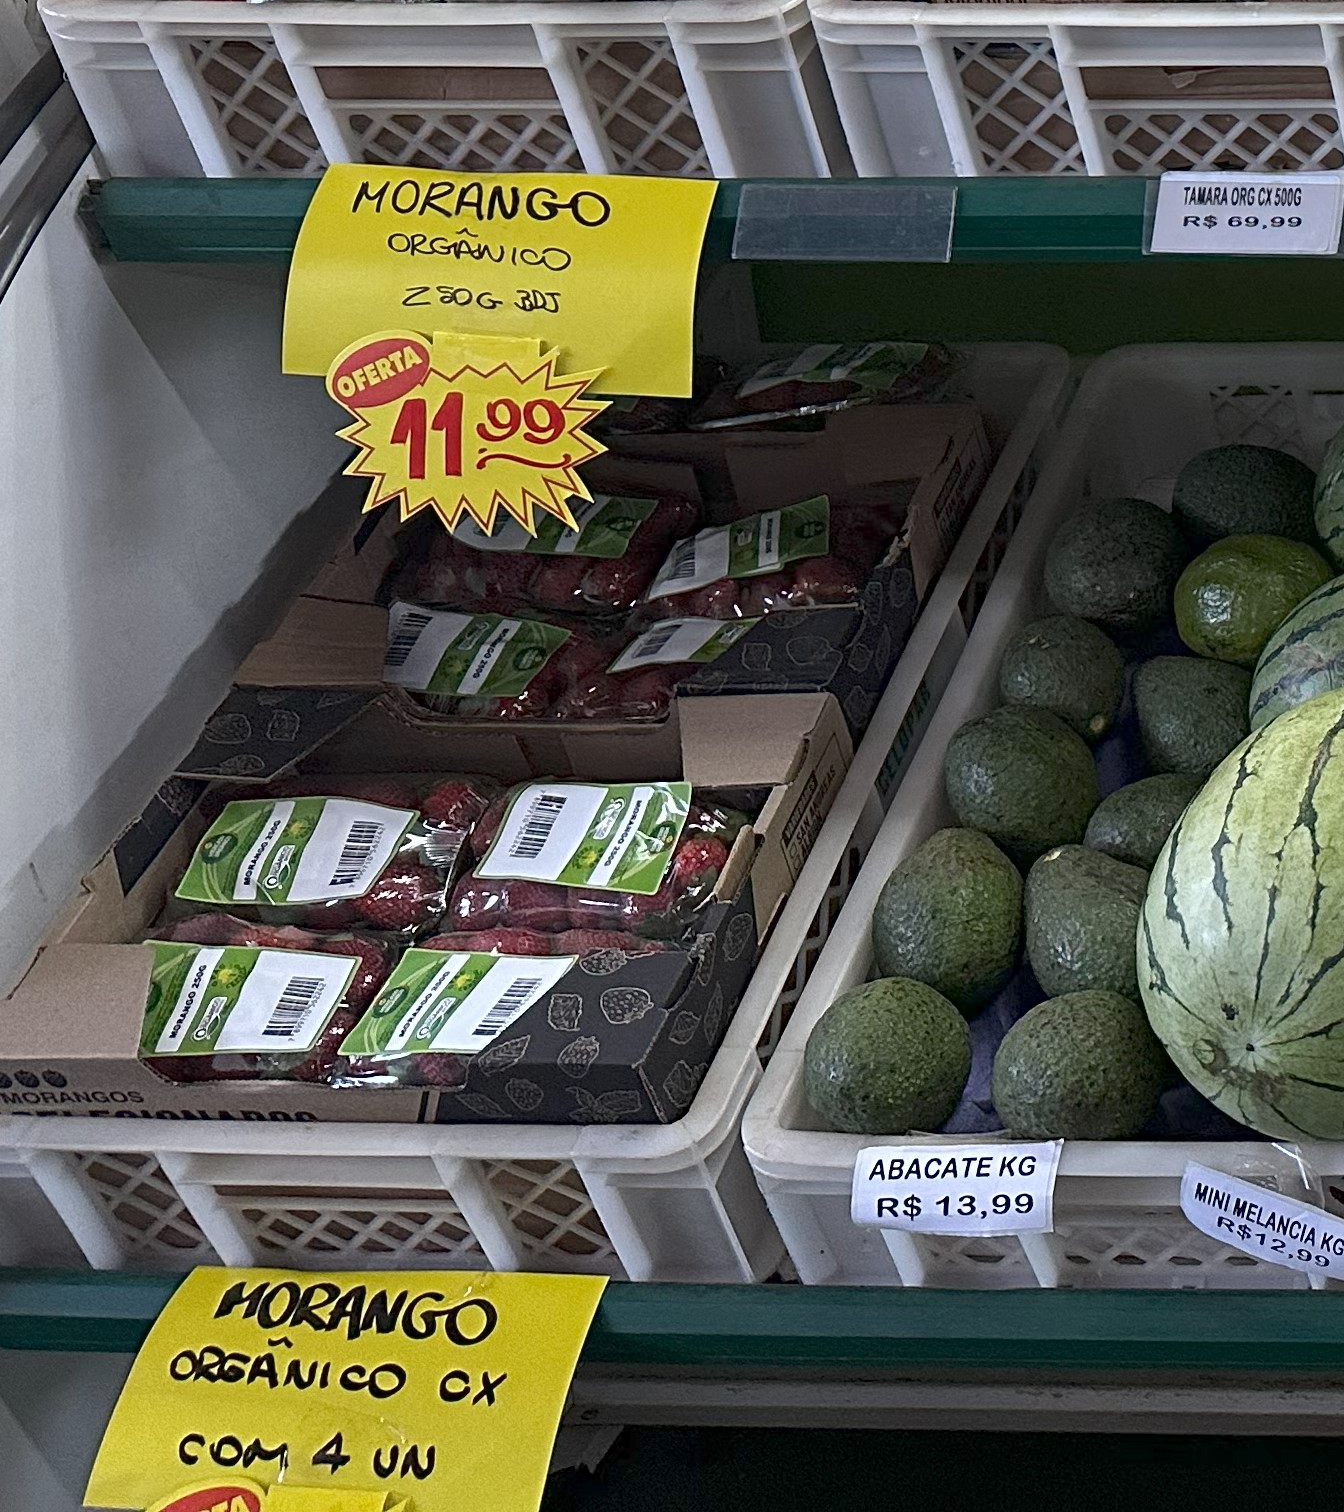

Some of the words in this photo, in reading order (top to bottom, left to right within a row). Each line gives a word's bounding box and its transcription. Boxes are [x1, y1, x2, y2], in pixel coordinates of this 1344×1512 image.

[352, 180, 610, 227] MORANGO
[1184, 187, 1228, 206] TAMARA
[1231, 187, 1255, 206] ORG
[1258, 187, 1272, 206] CX
[1274, 188, 1302, 206] 500G
[1183, 215, 1217, 229] R$
[1227, 216, 1302, 230] 69,99
[387, 228, 572, 271] ORGÂNICO
[402, 286, 503, 309] 250G
[336, 345, 423, 398] OFERTA
[618, 800, 642, 844] MORANGO
[244, 842, 268, 885] MORANGO
[266, 820, 281, 841] 250G
[169, 991, 196, 1038] MORANGO
[192, 965, 207, 989] 250G
[399, 993, 432, 1037] MORANGO
[869, 1157, 994, 1181] ABACATE
[1000, 1156, 1037, 1178] KG
[876, 1195, 921, 1219] R$
[935, 1193, 1035, 1219] 13,99
[1195, 1182, 1231, 1212] MINI
[1233, 1198, 1316, 1247] MELANCIA
[1217, 1216, 1330, 1268] R$12,99
[214, 1281, 498, 1345] MORANGO
[169, 1337, 407, 1398] ORGÂNICO
[440, 1370, 507, 1406] CX
[179, 1433, 289, 1469] COM
[312, 1432, 350, 1474] 4
[373, 1445, 437, 1480] UN
